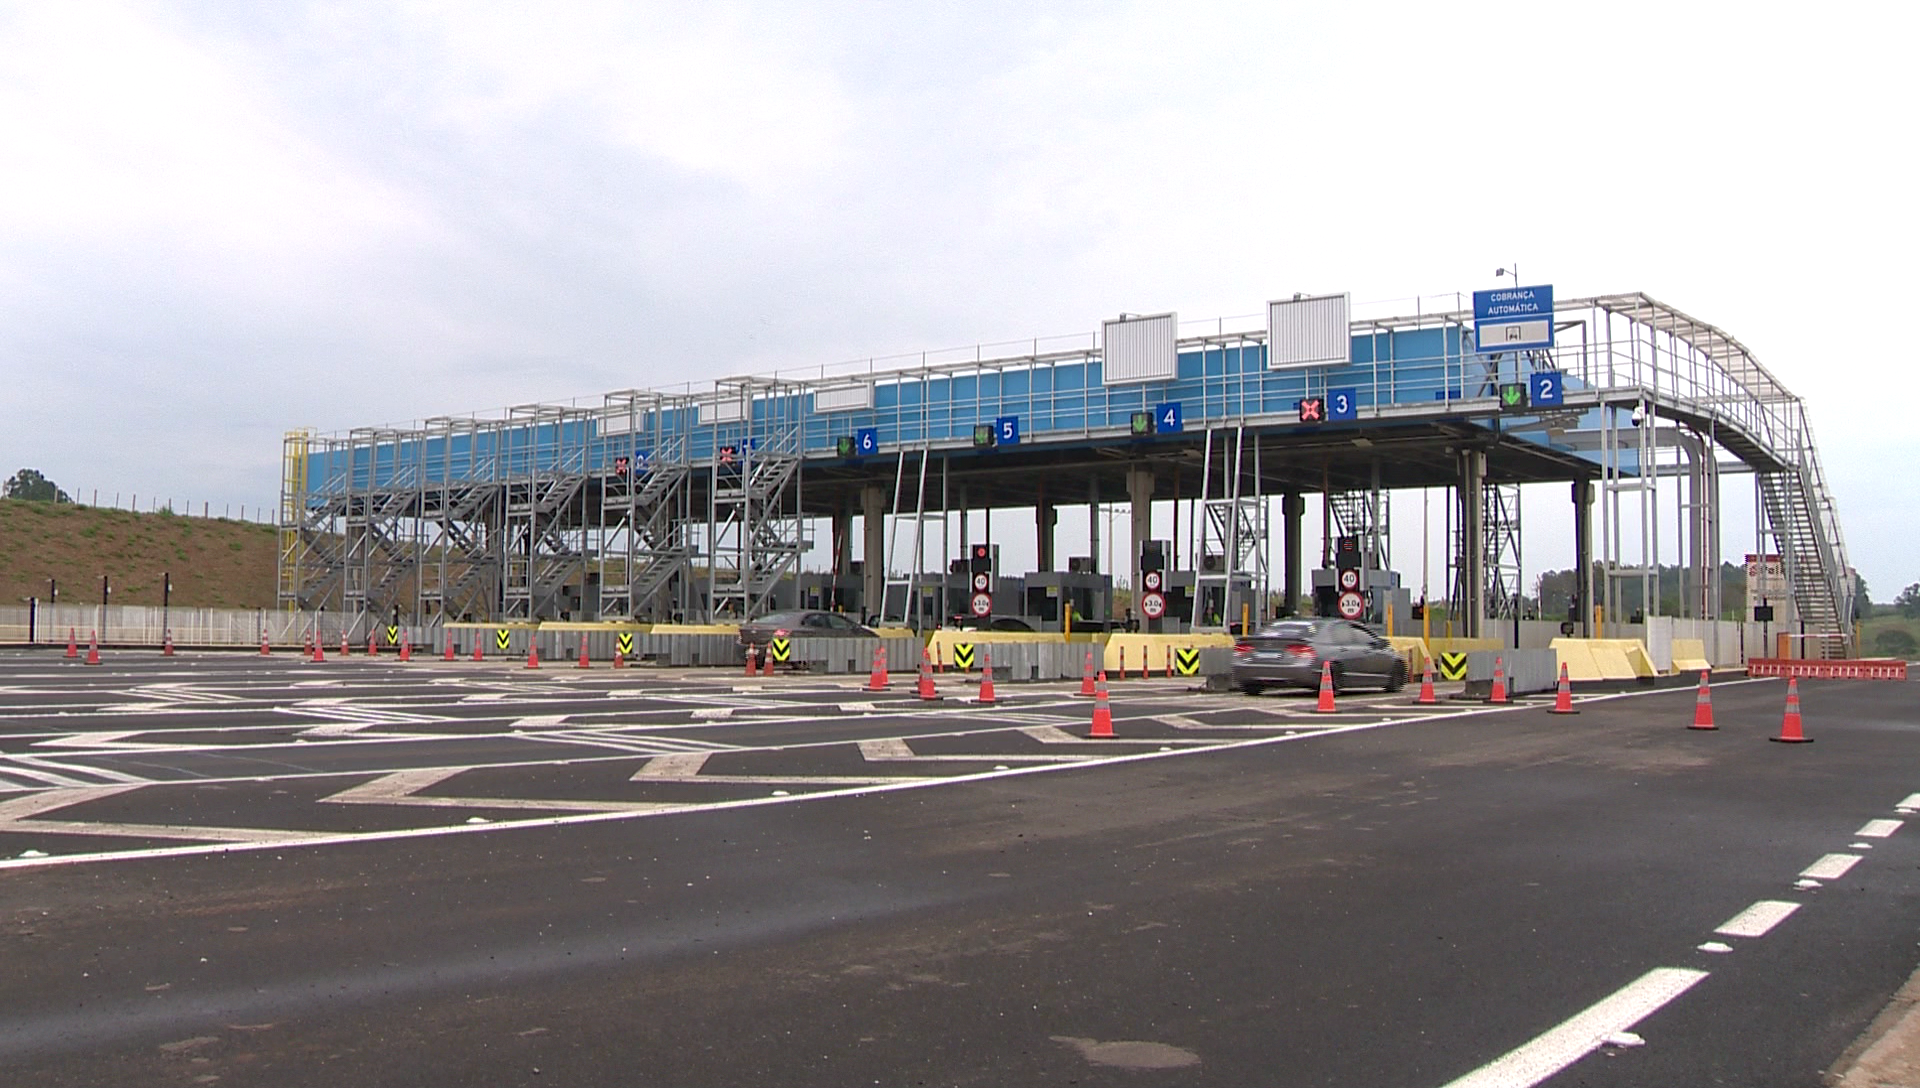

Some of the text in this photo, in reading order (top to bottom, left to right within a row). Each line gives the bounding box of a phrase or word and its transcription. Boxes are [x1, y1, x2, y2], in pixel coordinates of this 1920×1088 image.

[1491, 290, 1535, 302] COBRANÇA
[1488, 302, 1539, 315] AUTOMÁTICA
[1540, 379, 1553, 399] 2
[1336, 395, 1348, 413] 3
[1163, 408, 1175, 427] 4
[1003, 422, 1013, 439] 5
[863, 433, 872, 450] 6
[976, 577, 986, 585] 40
[1147, 575, 1158, 584] 40
[1343, 574, 1355, 583] 40
